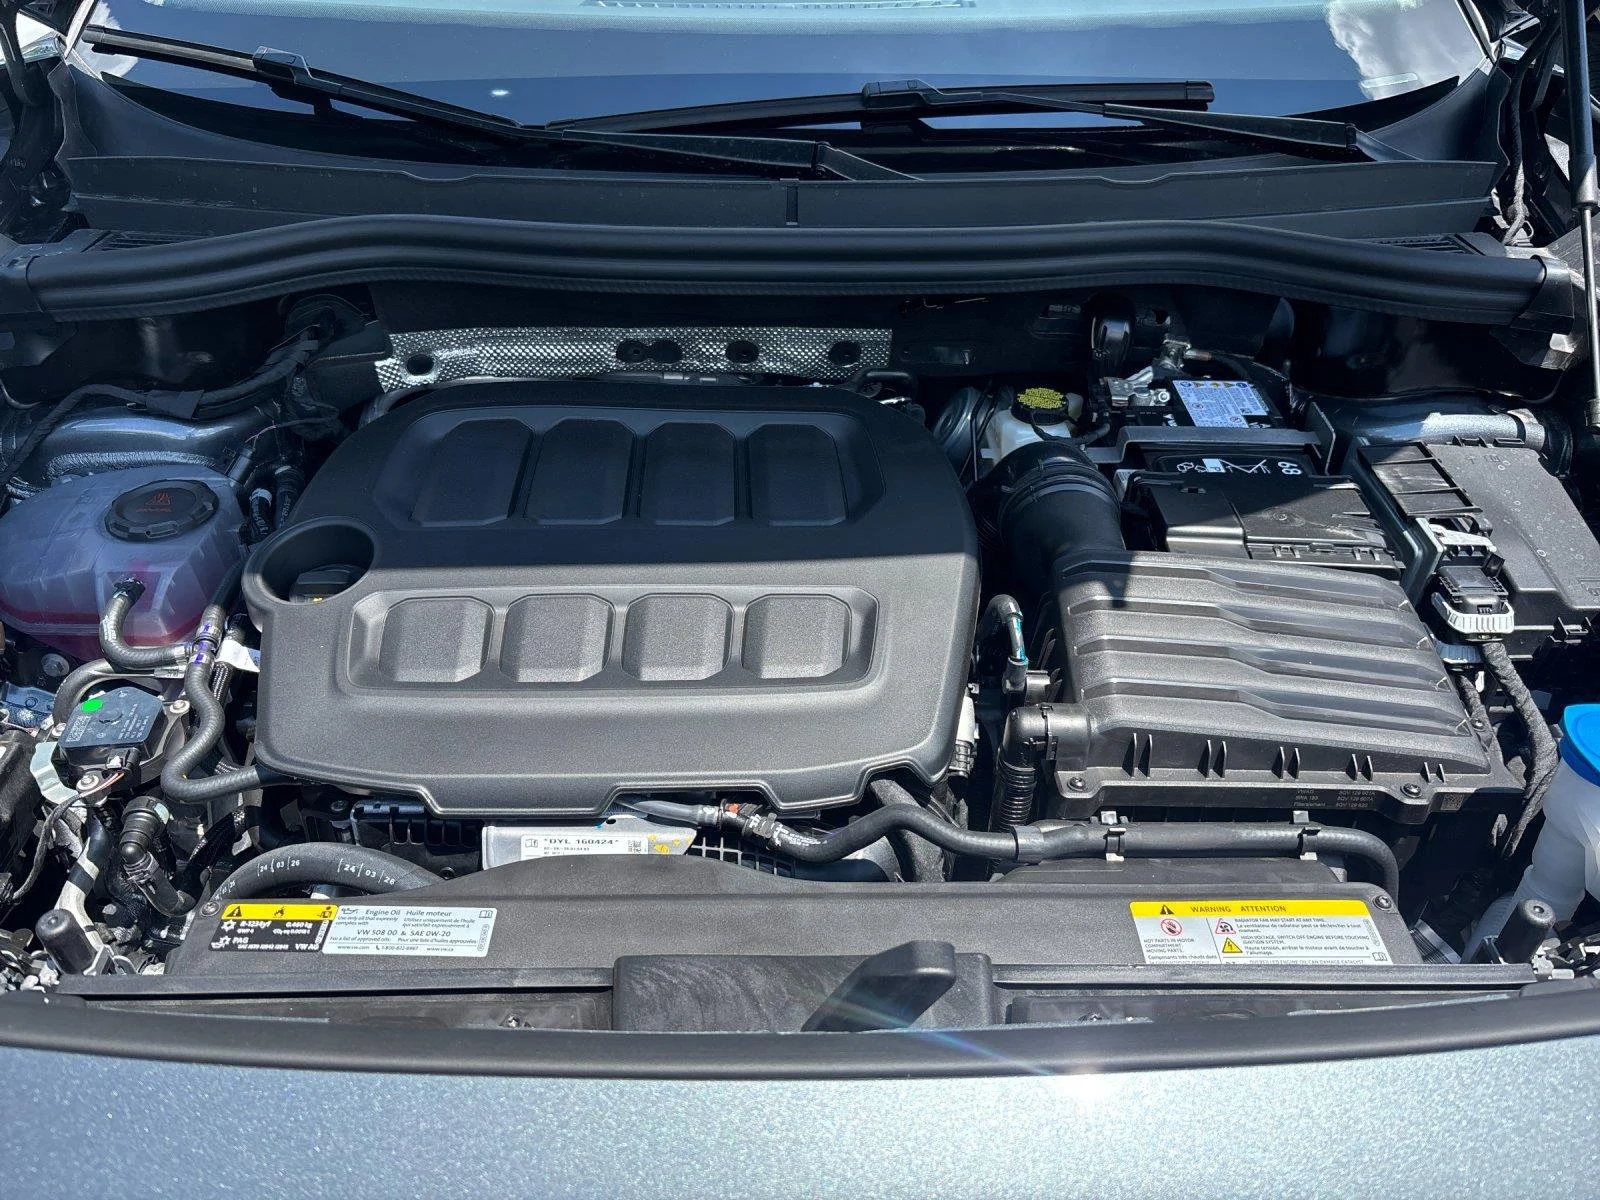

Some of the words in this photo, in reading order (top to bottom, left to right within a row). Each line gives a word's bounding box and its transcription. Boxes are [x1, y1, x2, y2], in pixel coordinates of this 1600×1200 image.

[276, 861, 285, 869] 03
[290, 859, 300, 867] 26
[344, 864, 356, 873] 24
[365, 869, 376, 878] 03
[383, 876, 395, 885] 26
[365, 909, 389, 917] Engine
